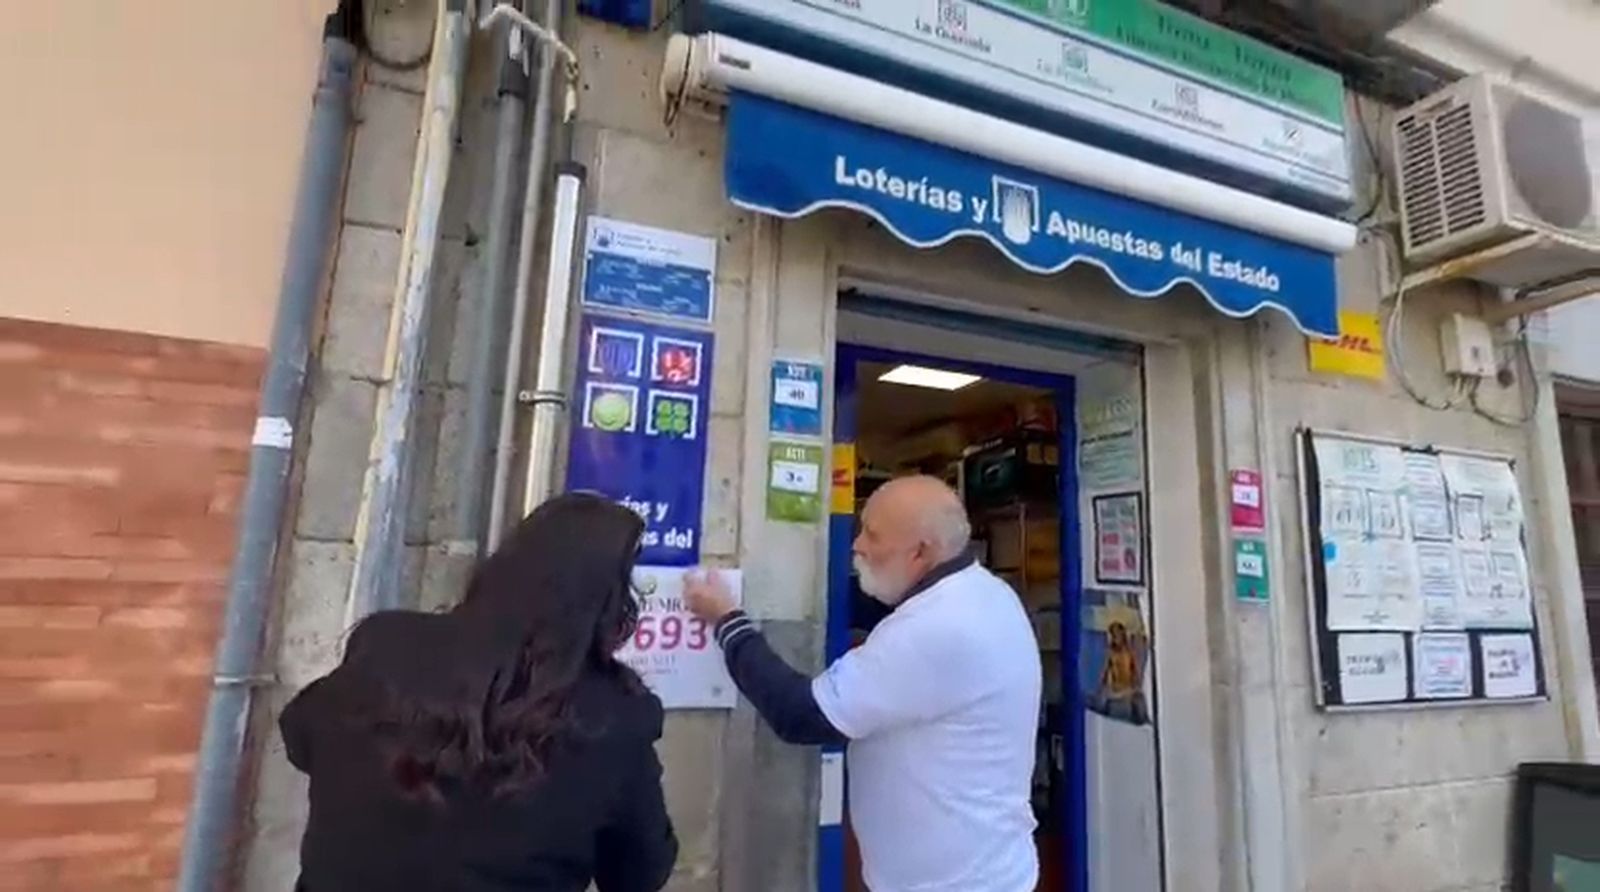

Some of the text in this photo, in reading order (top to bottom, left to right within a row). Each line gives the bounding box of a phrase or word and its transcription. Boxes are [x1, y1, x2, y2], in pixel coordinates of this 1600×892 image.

[834, 155, 988, 223] Loterías y
[1046, 211, 1281, 291] Apuestas del Estado
[656, 502, 669, 522] y
[664, 527, 693, 549] del
